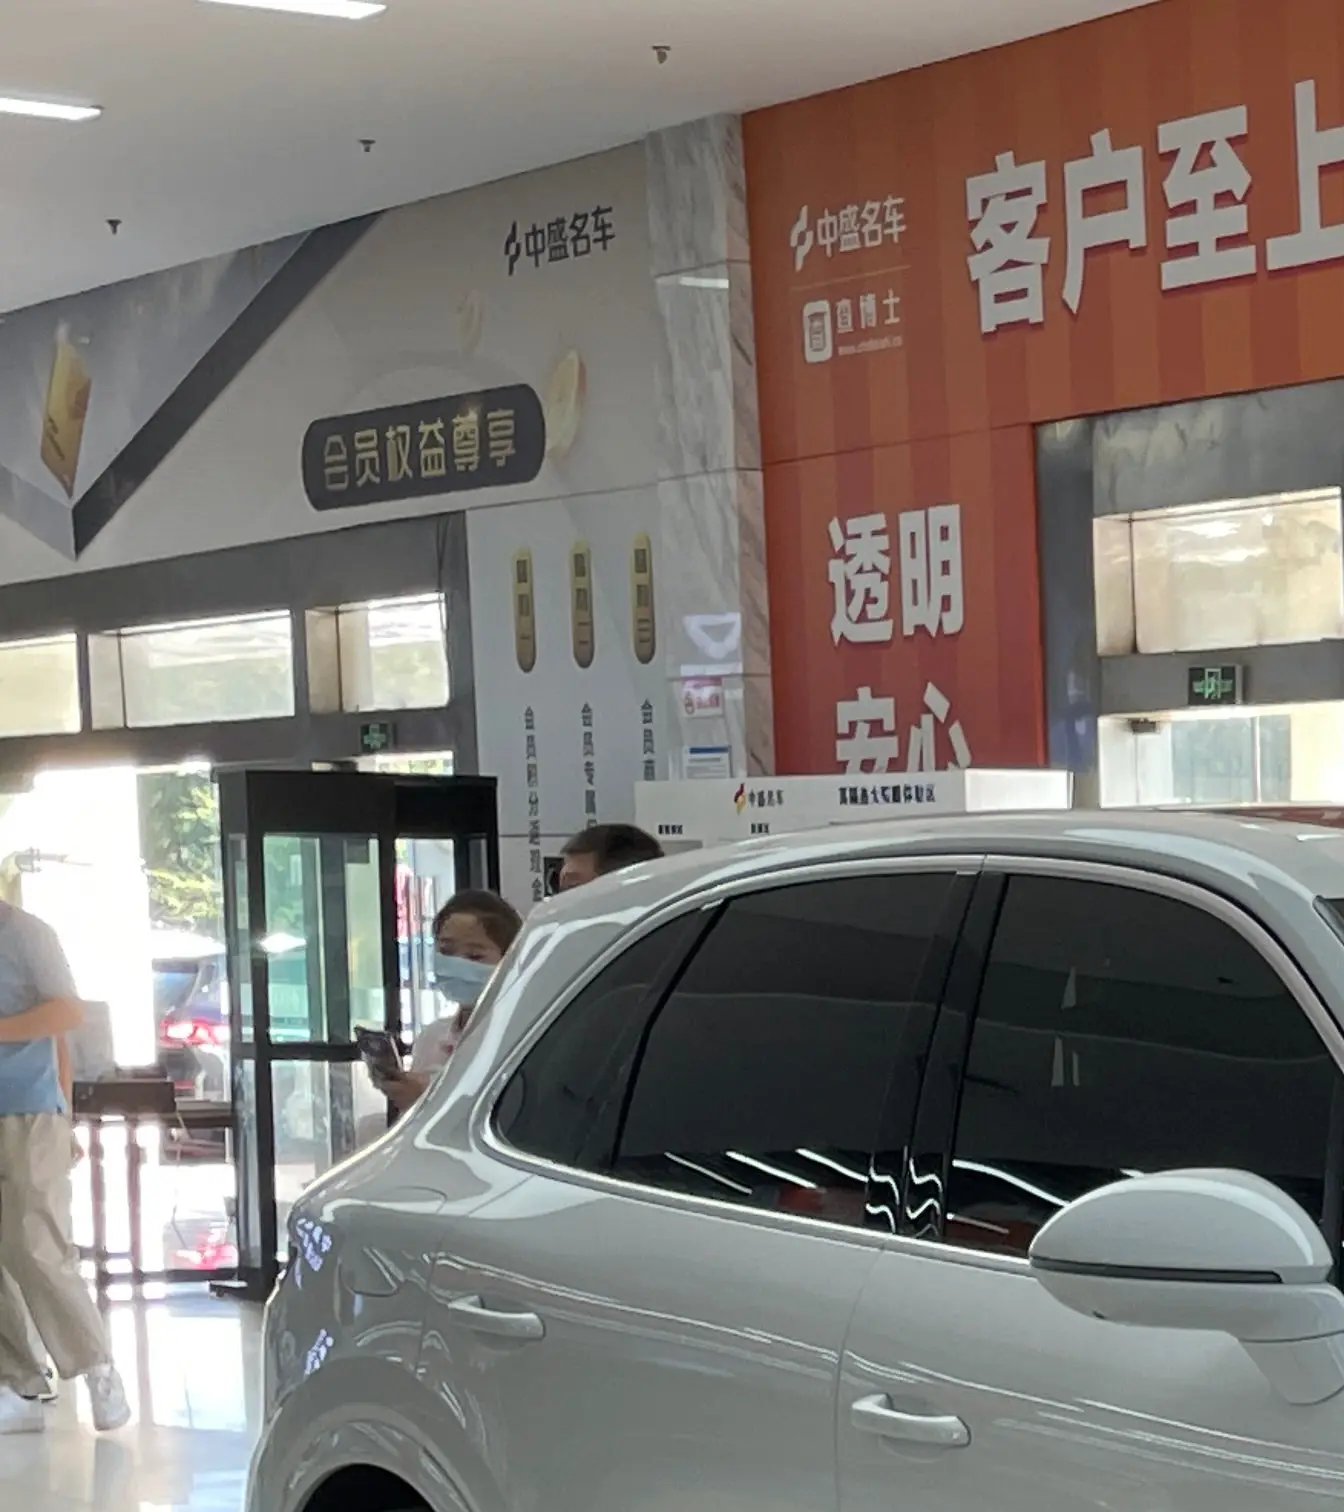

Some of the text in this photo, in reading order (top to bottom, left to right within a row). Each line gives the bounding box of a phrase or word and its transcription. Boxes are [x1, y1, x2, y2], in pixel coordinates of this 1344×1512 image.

[524, 206, 616, 268] 中盛名车
[817, 195, 907, 258] 中盛名车
[323, 407, 516, 492] 会员权益尊享
[827, 504, 965, 646] 透明
[835, 682, 972, 775] 安心
